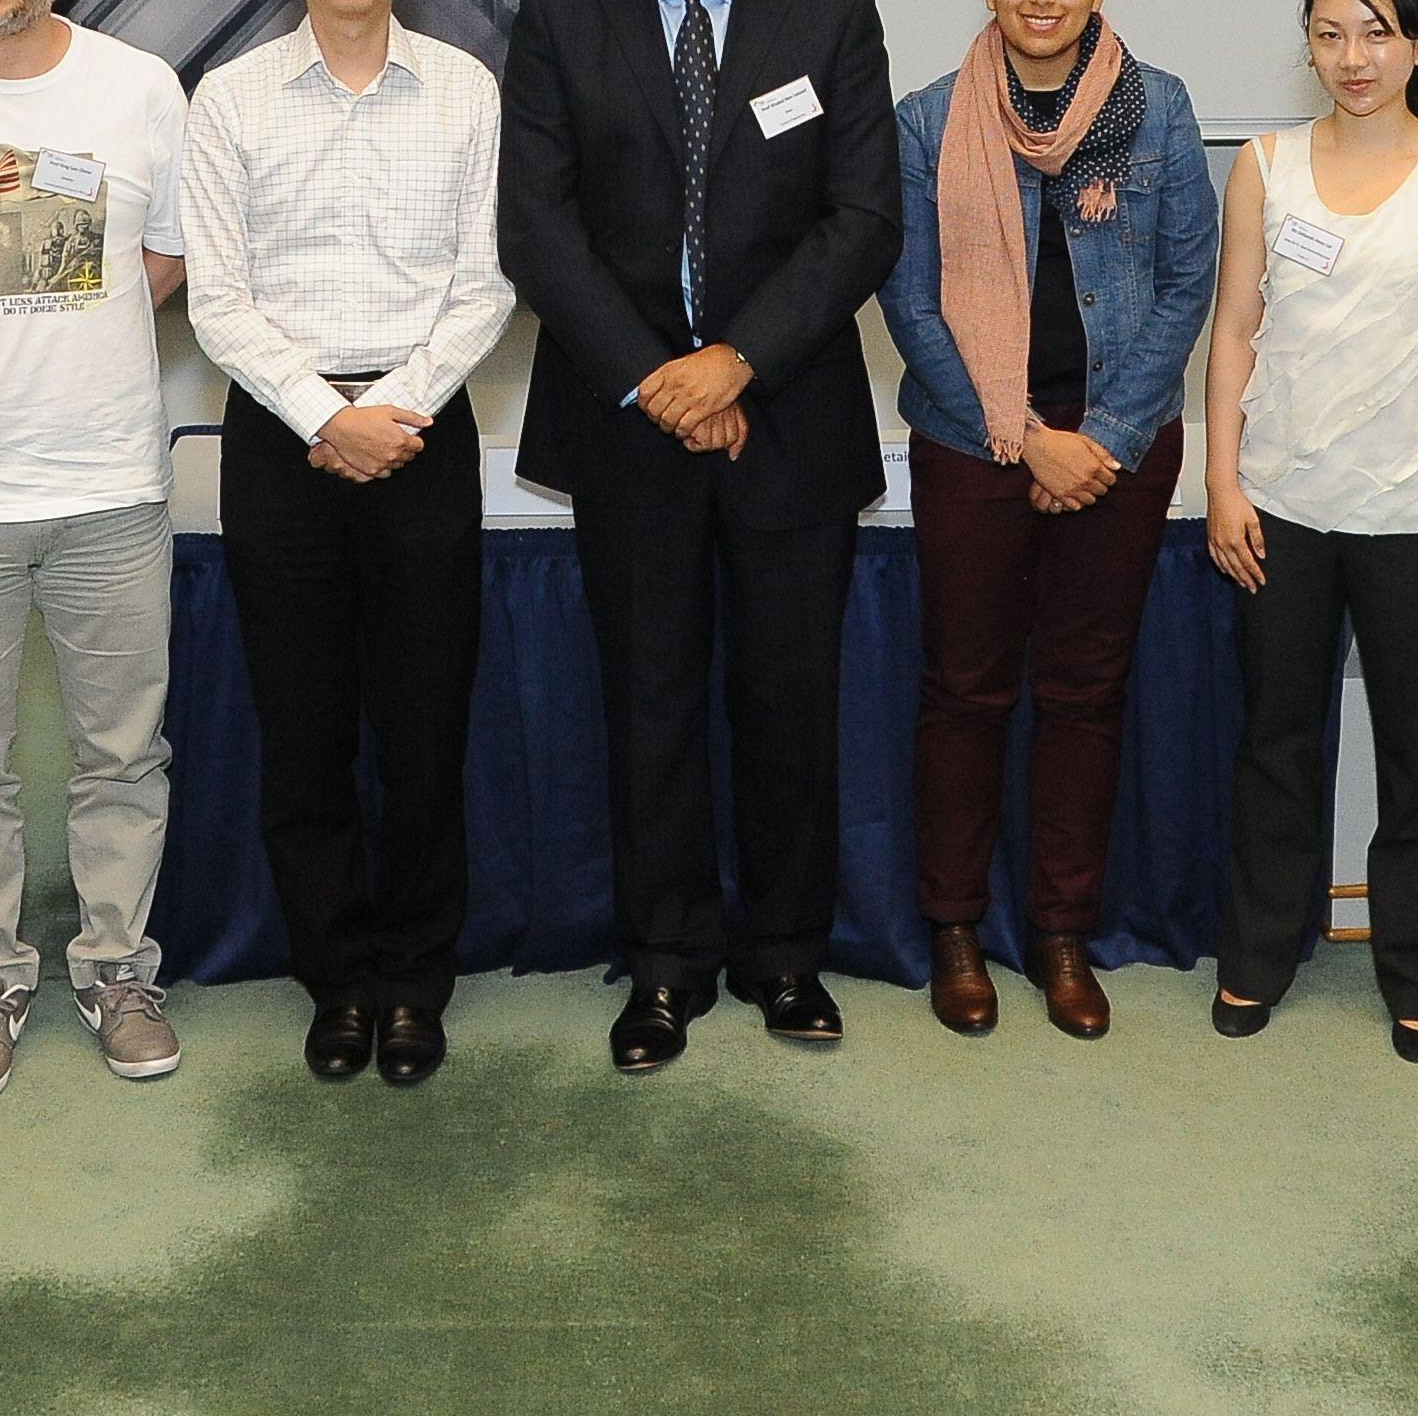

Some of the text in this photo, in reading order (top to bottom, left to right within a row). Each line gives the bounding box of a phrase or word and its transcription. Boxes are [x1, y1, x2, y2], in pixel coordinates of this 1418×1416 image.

[9, 296, 32, 306] LESS
[34, 294, 69, 305] ATTACK
[3, 307, 17, 316] DO
[19, 306, 27, 315] IT
